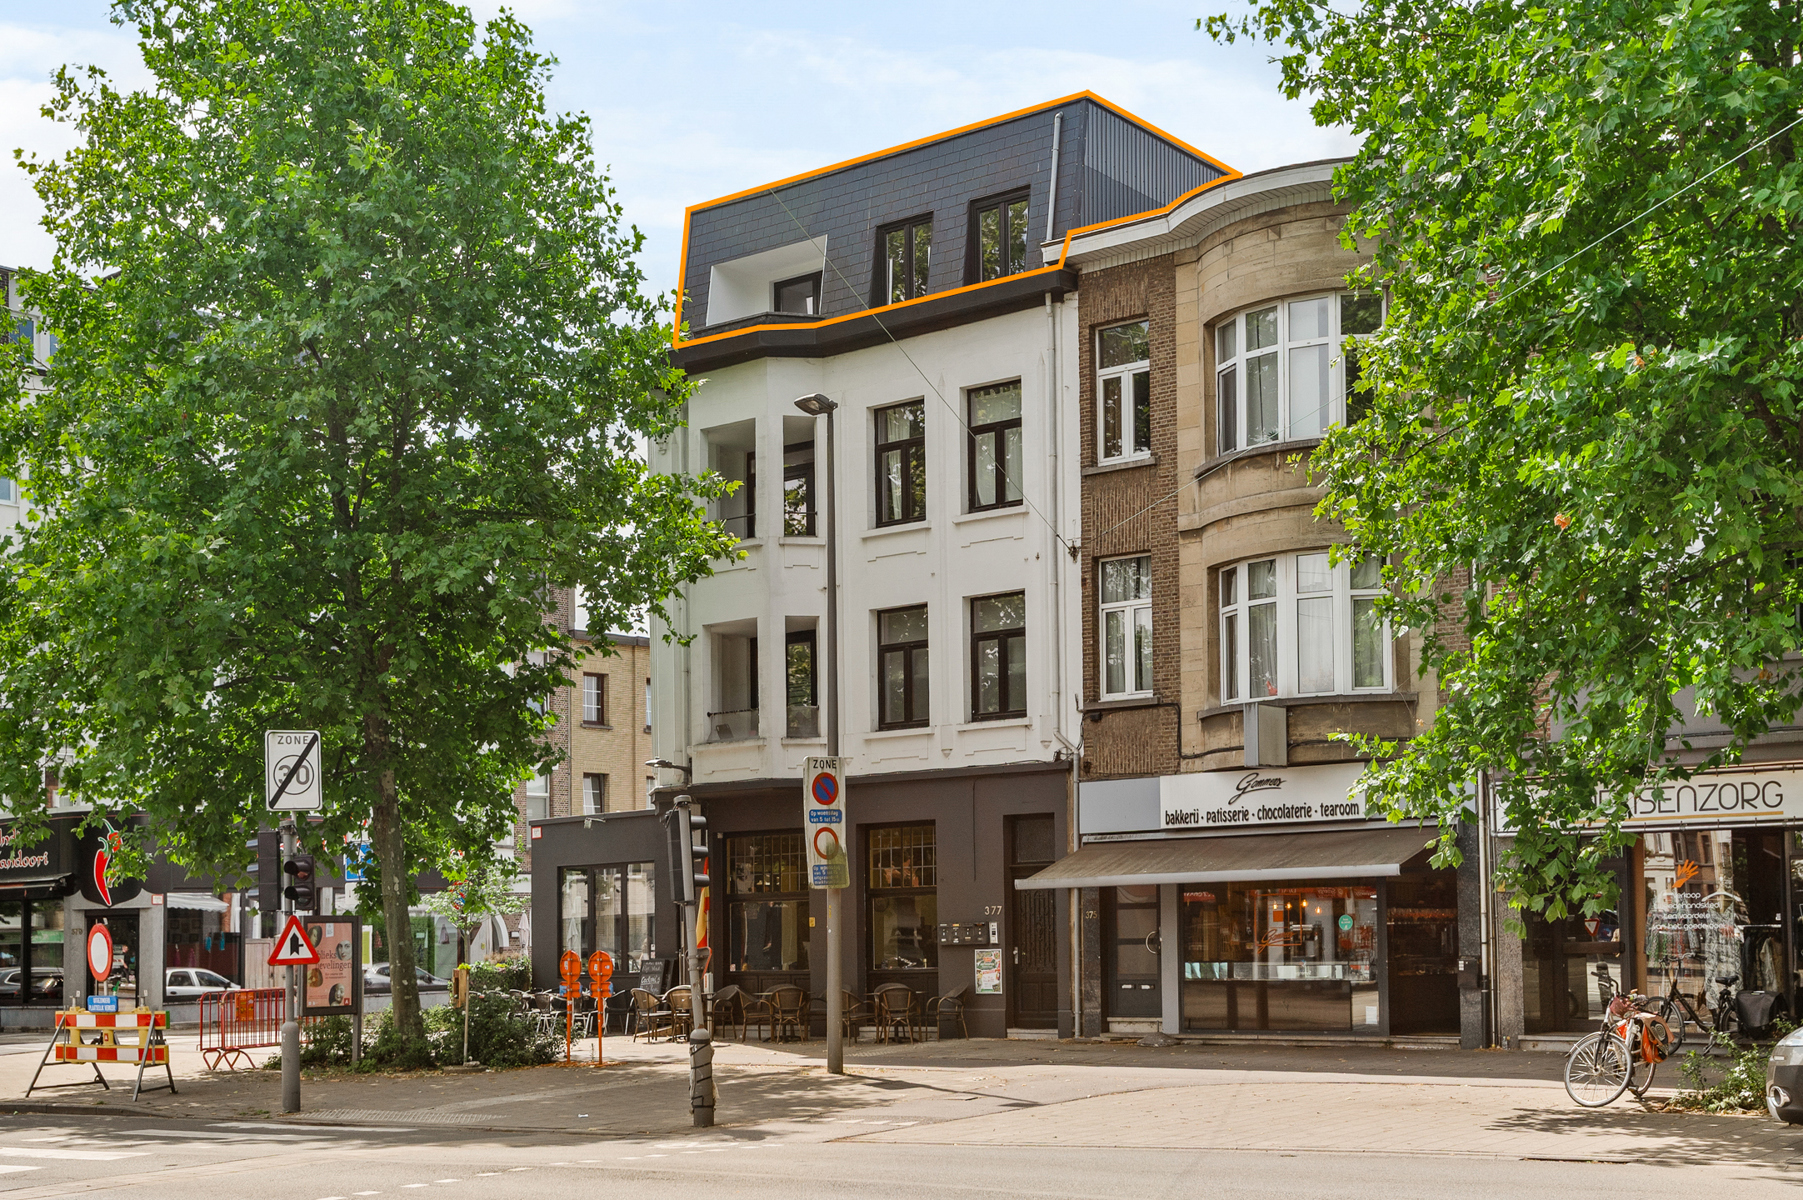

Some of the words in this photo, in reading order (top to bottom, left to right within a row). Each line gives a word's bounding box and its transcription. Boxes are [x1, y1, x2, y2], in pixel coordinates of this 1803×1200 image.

[277, 735, 309, 745] ZONE
[812, 760, 837, 769] ZONE
[278, 764, 310, 785] 30
[1165, 809, 1199, 825] bakkerij
[1206, 806, 1250, 823] patisserie
[1257, 802, 1312, 820] chocolaterie
[1320, 802, 1360, 817] tearoom
[0, 849, 49, 870] andoori
[984, 906, 1002, 915] 377
[1085, 910, 1098, 919] 375
